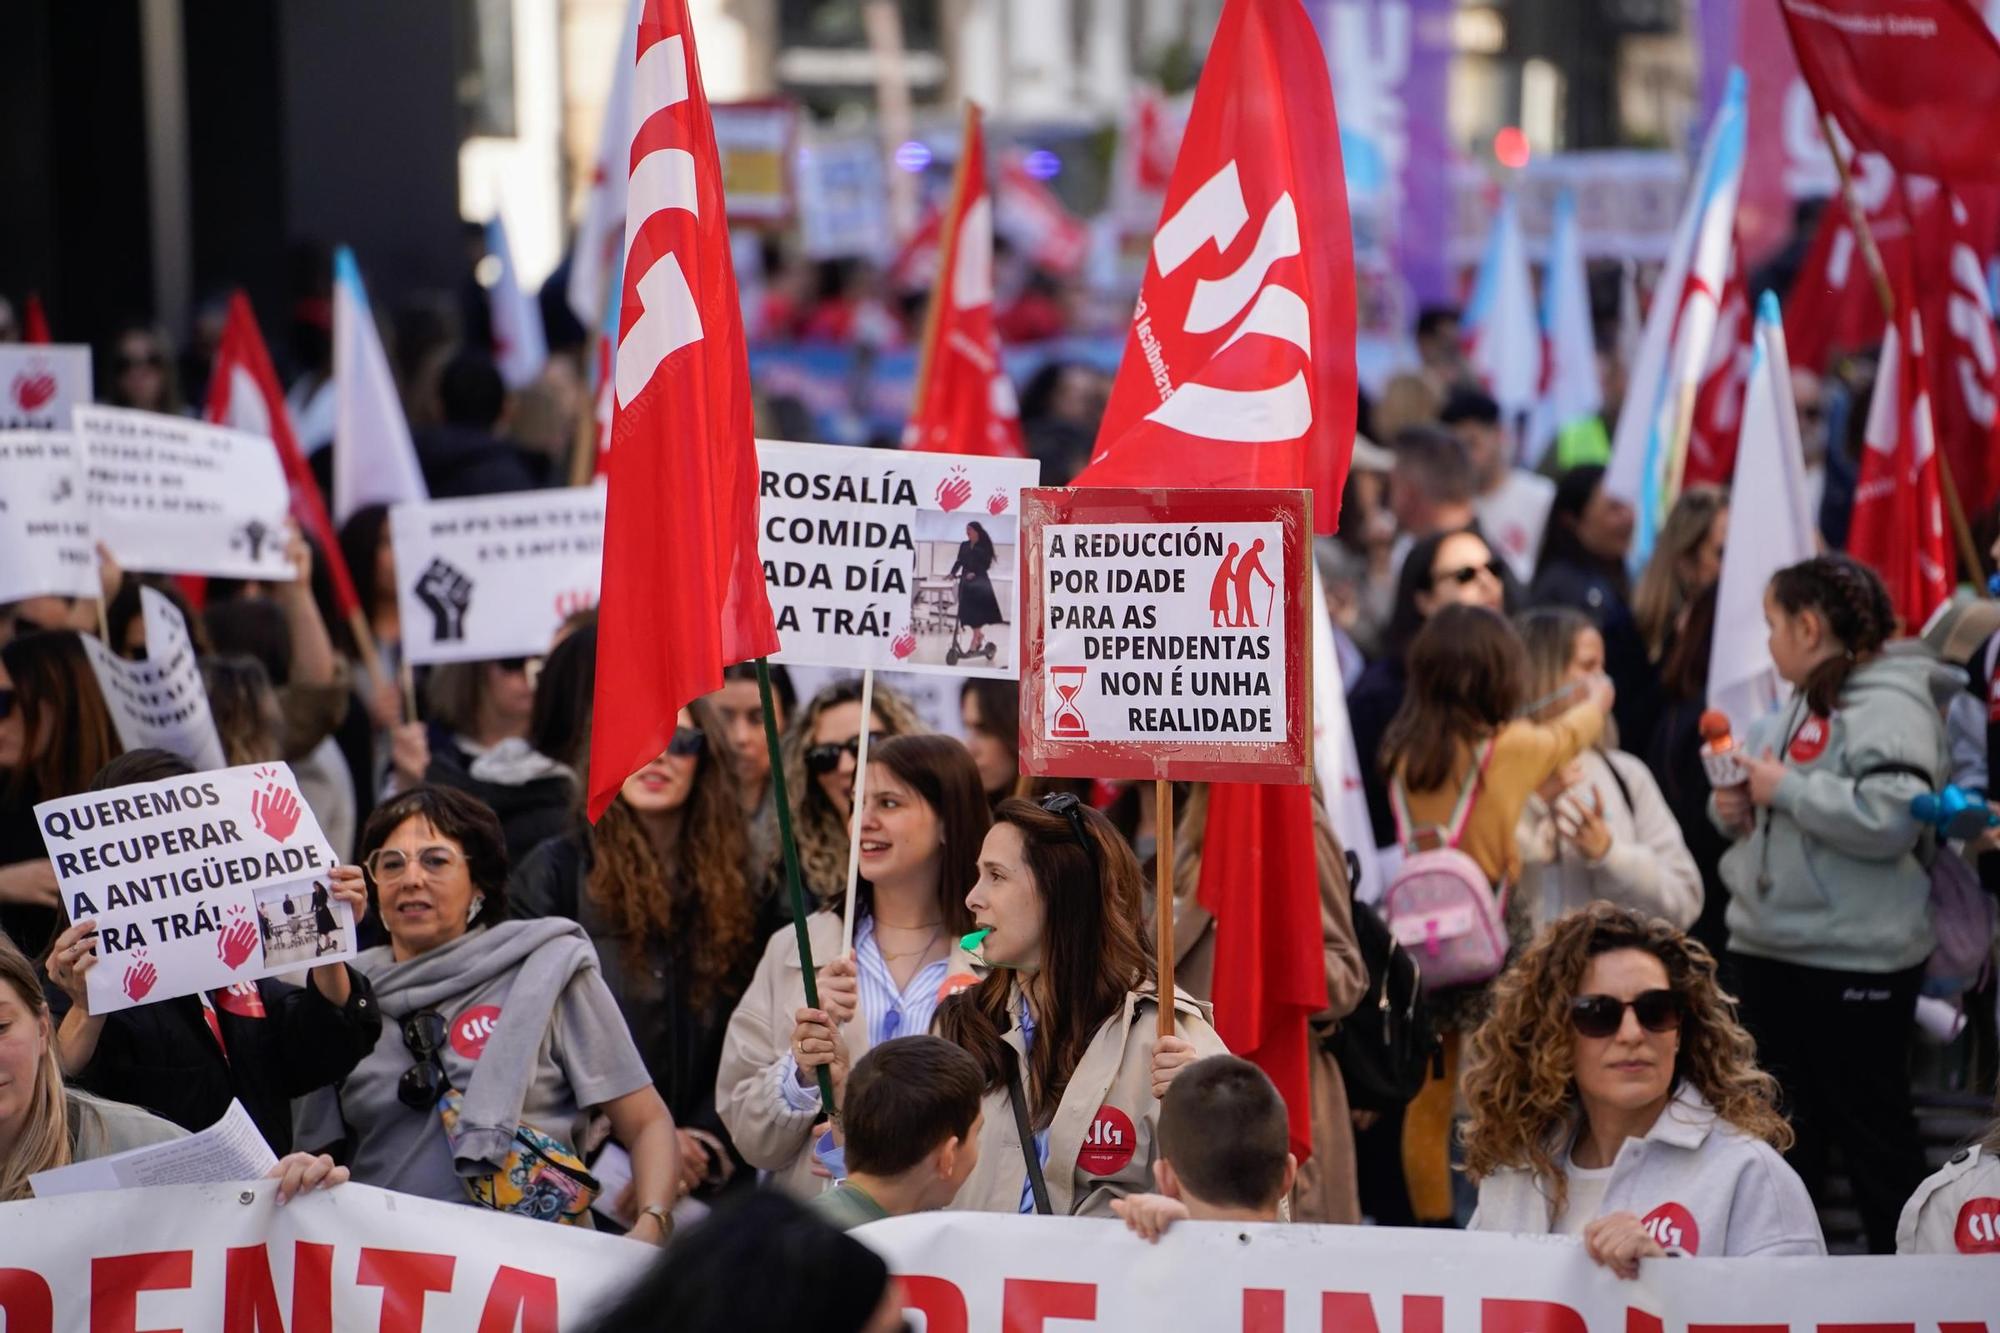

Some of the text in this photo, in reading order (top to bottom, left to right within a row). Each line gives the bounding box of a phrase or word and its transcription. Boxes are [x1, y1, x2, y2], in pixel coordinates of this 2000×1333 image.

[760, 470, 918, 506] ROSALÍA
[766, 516, 915, 551] COMIDA
[1049, 526, 1223, 558] A REDUCCIÓN
[845, 559, 907, 594] DÍA
[1050, 568, 1186, 594] POR IDADE
[776, 603, 891, 638] A TRÁ!
[1050, 605, 1157, 630] PARA AS
[1084, 635, 1271, 661] DEPENDENTAS
[1100, 665, 1271, 696] NON É UNHA
[1128, 707, 1272, 733] REALIDADE
[44, 783, 220, 841] QUEREMOS
[56, 819, 243, 879] RECUPERAR
[73, 845, 322, 920] A ANTIGÜEDADE
[152, 900, 223, 942] TRÁ!
[1968, 1212, 2000, 1242] CI
